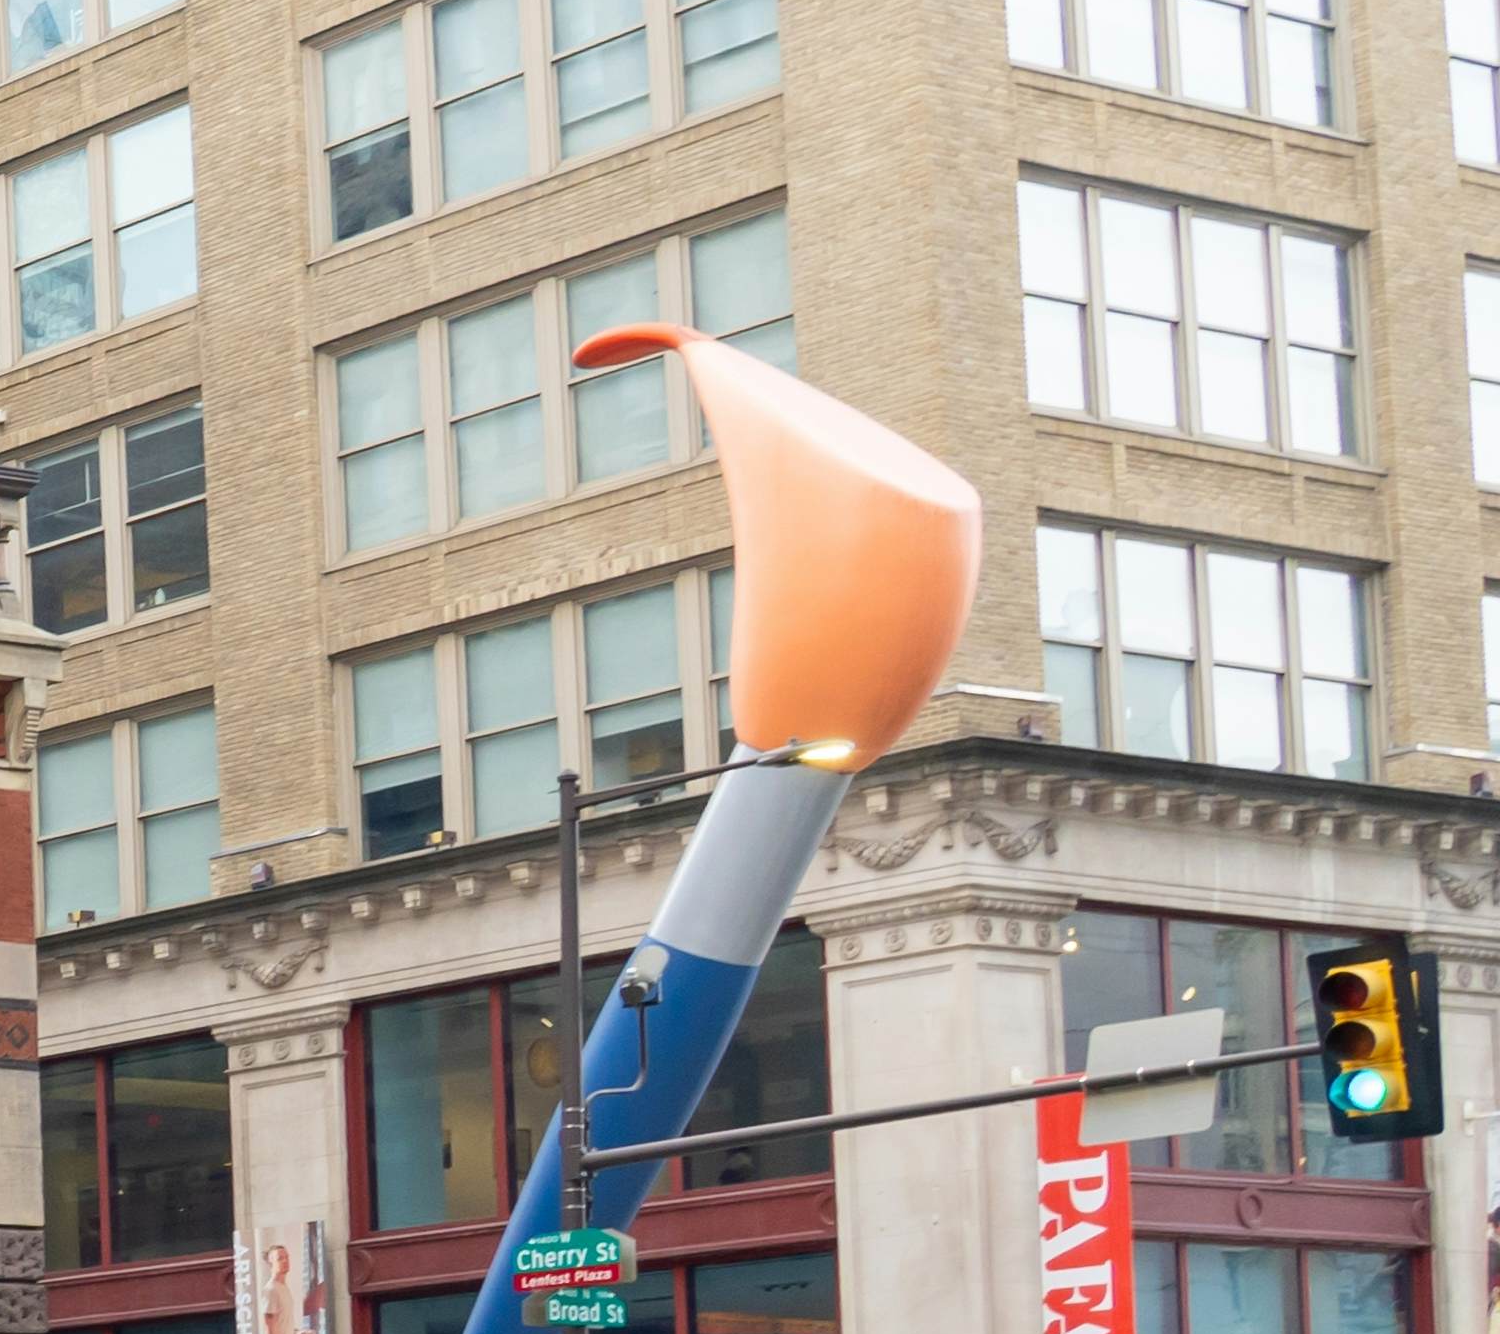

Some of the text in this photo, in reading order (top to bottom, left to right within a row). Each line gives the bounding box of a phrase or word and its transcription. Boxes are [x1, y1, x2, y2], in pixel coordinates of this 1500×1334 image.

[234, 1244, 250, 1289] ART
[516, 1242, 618, 1270] Cherry St
[521, 1269, 612, 1288] Lenfest Plaza
[548, 1299, 624, 1324] Broad St
